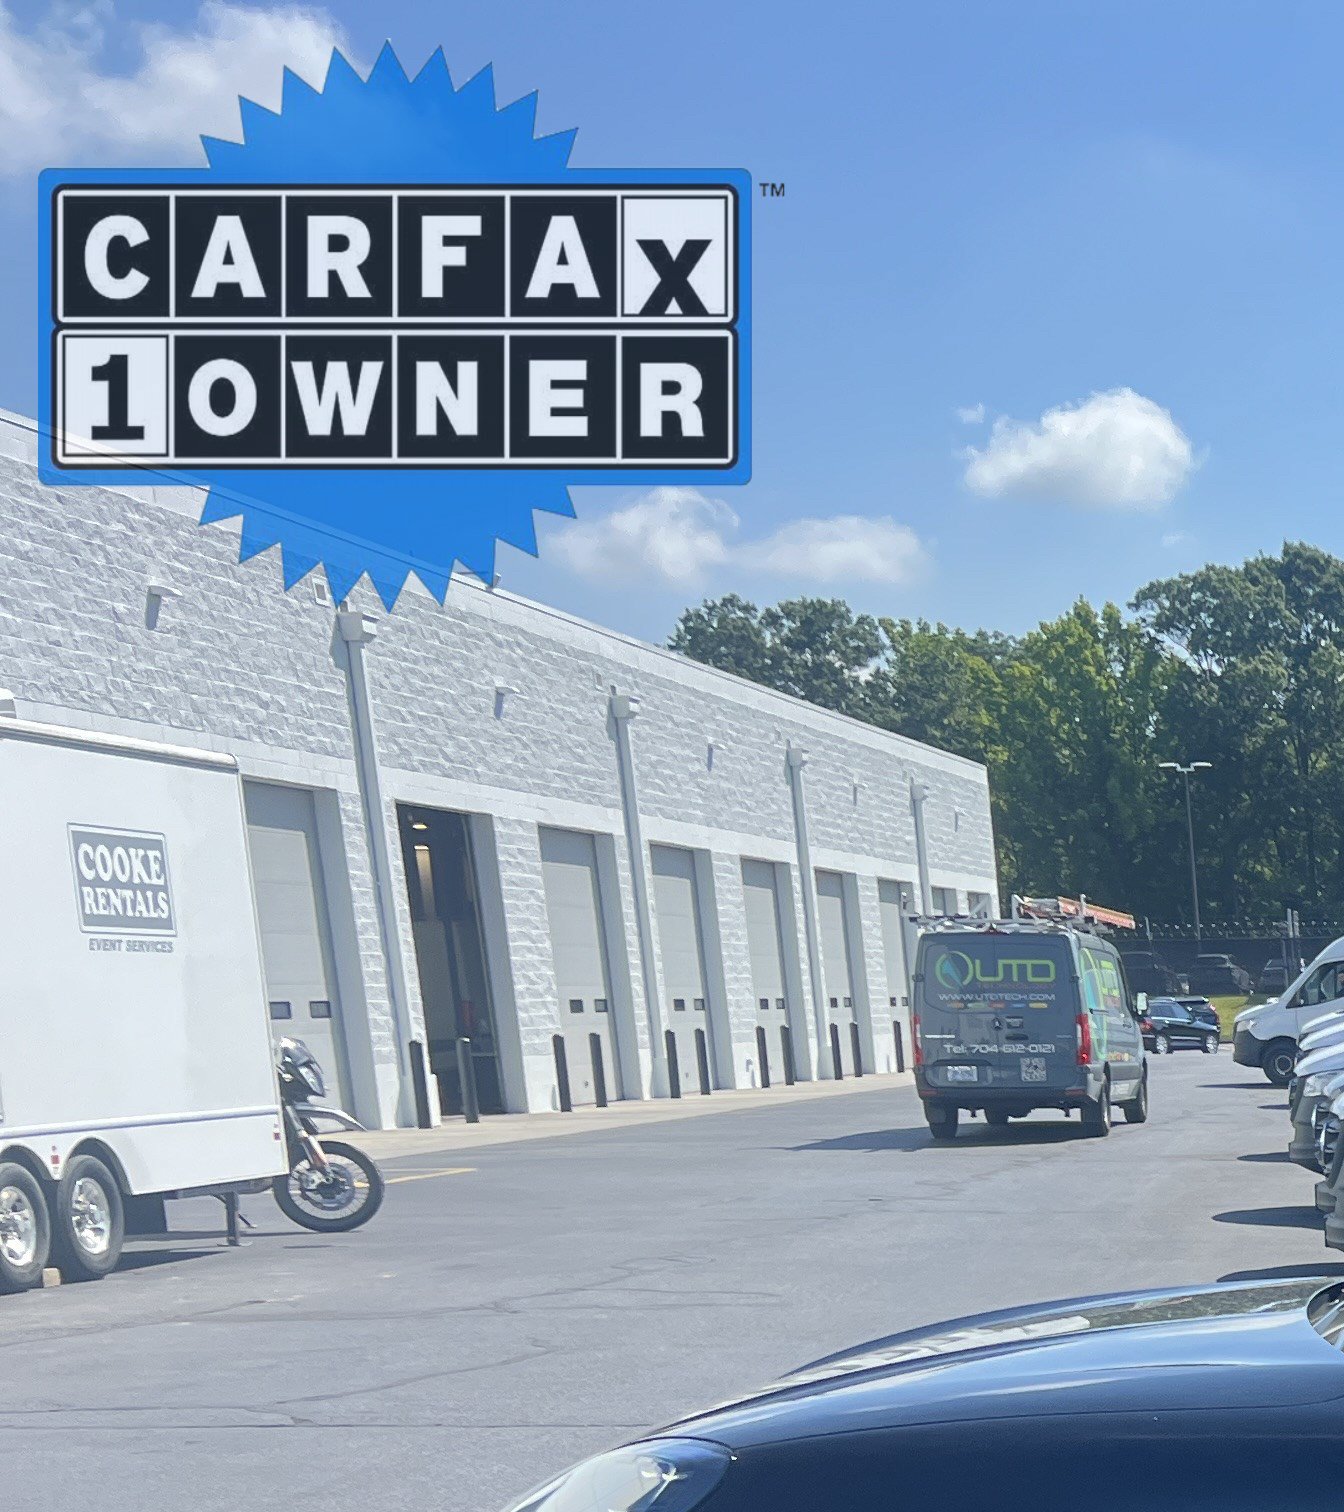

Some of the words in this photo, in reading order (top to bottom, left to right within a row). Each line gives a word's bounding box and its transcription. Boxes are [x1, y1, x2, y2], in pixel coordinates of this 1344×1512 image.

[77, 842, 165, 885] COOKE
[81, 886, 169, 918] RENTALS
[88, 938, 123, 952] EVENT
[125, 939, 174, 953] SERVICES
